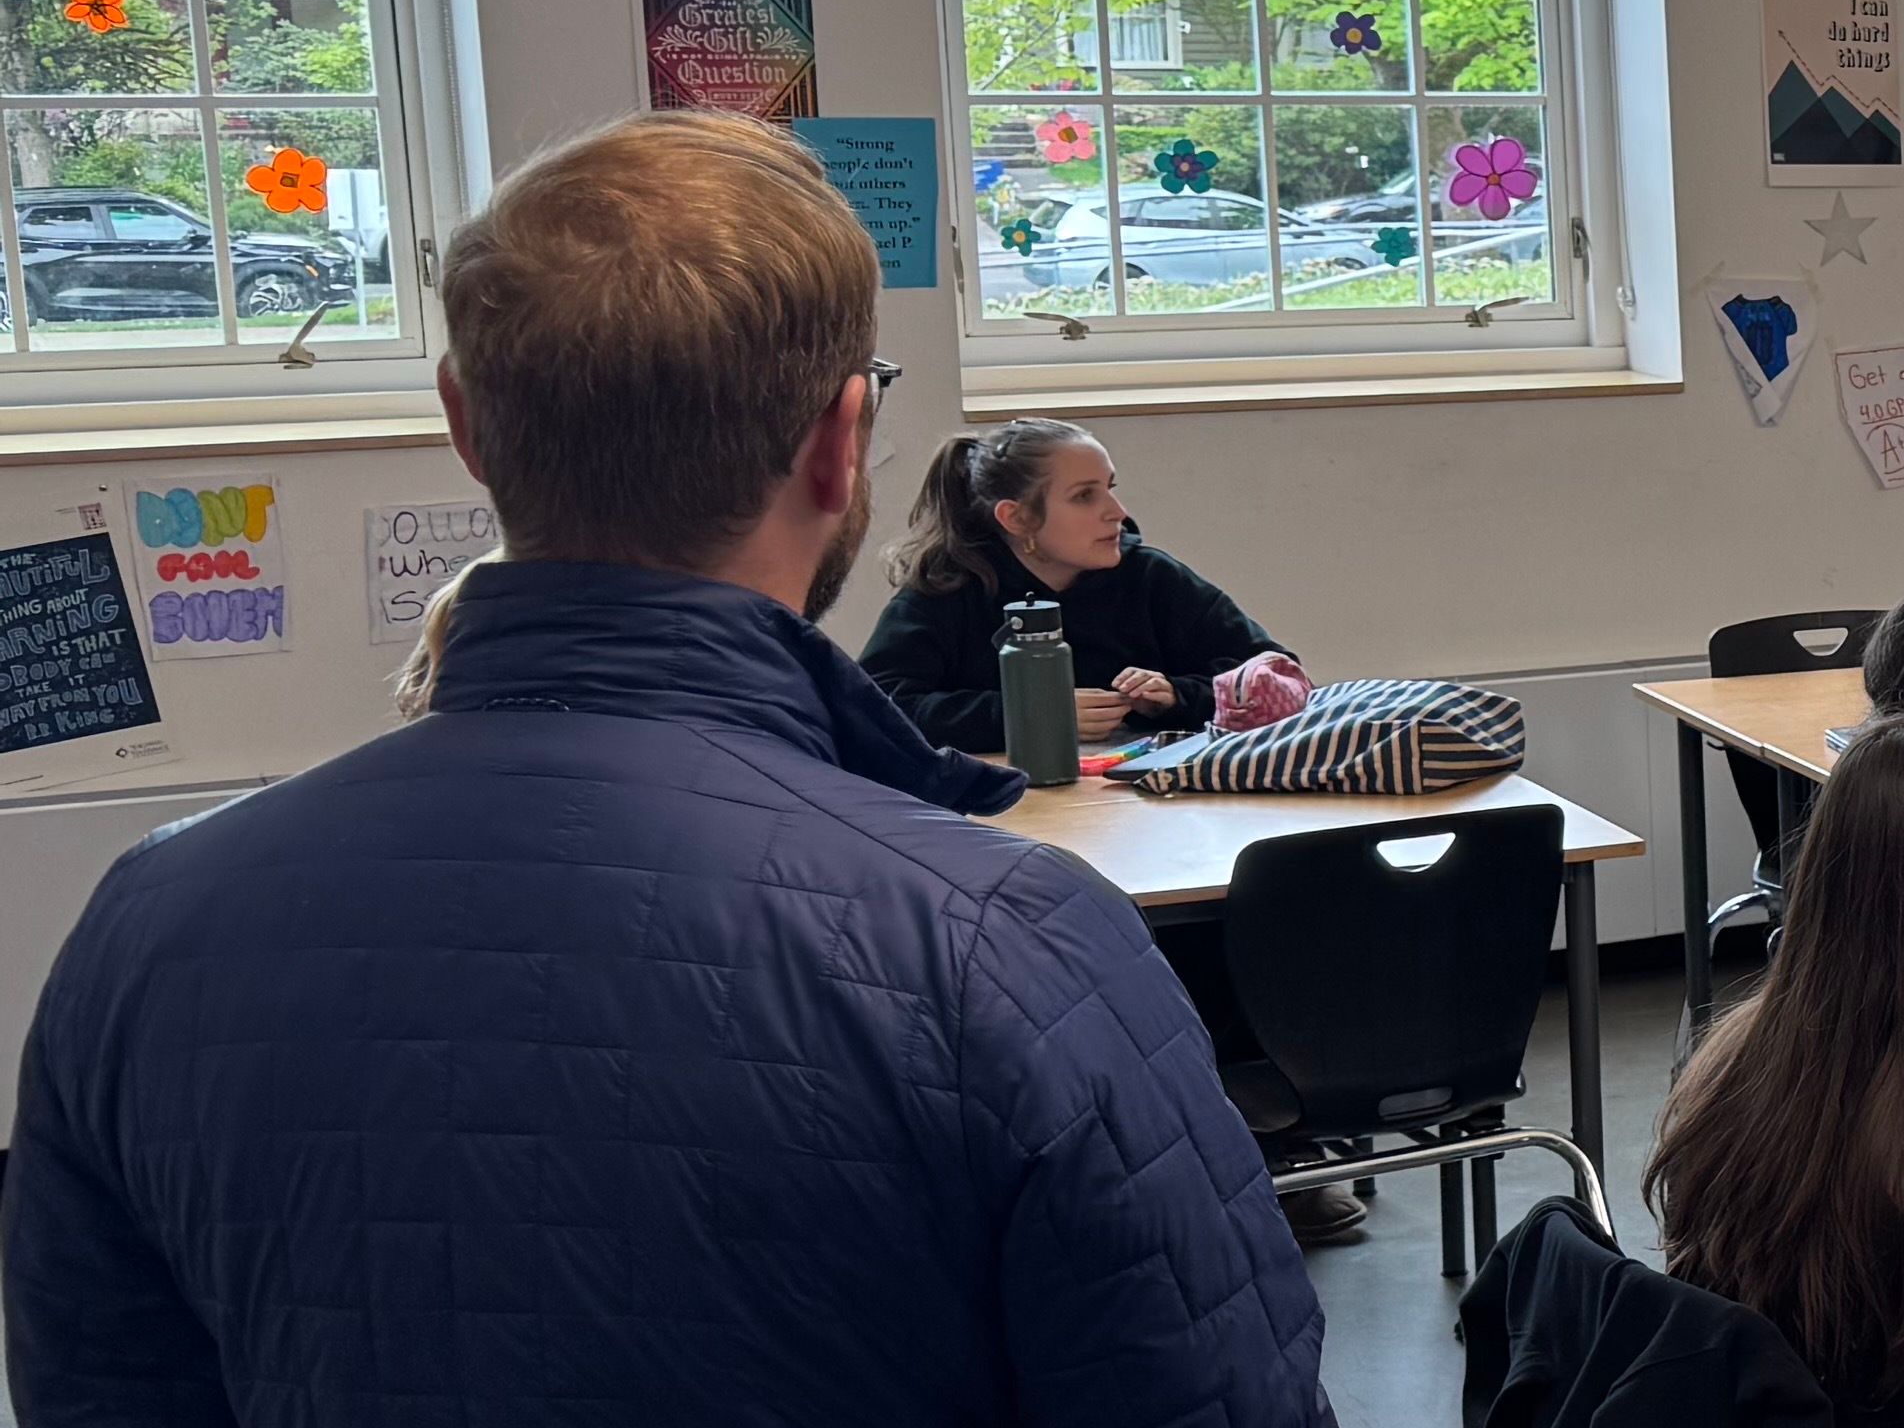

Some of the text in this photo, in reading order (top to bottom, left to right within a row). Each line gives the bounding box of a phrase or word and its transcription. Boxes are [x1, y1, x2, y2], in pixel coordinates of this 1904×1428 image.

[1861, 0, 1889, 16] can
[1851, 22, 1889, 43] hard
[1838, 48, 1890, 72] things
